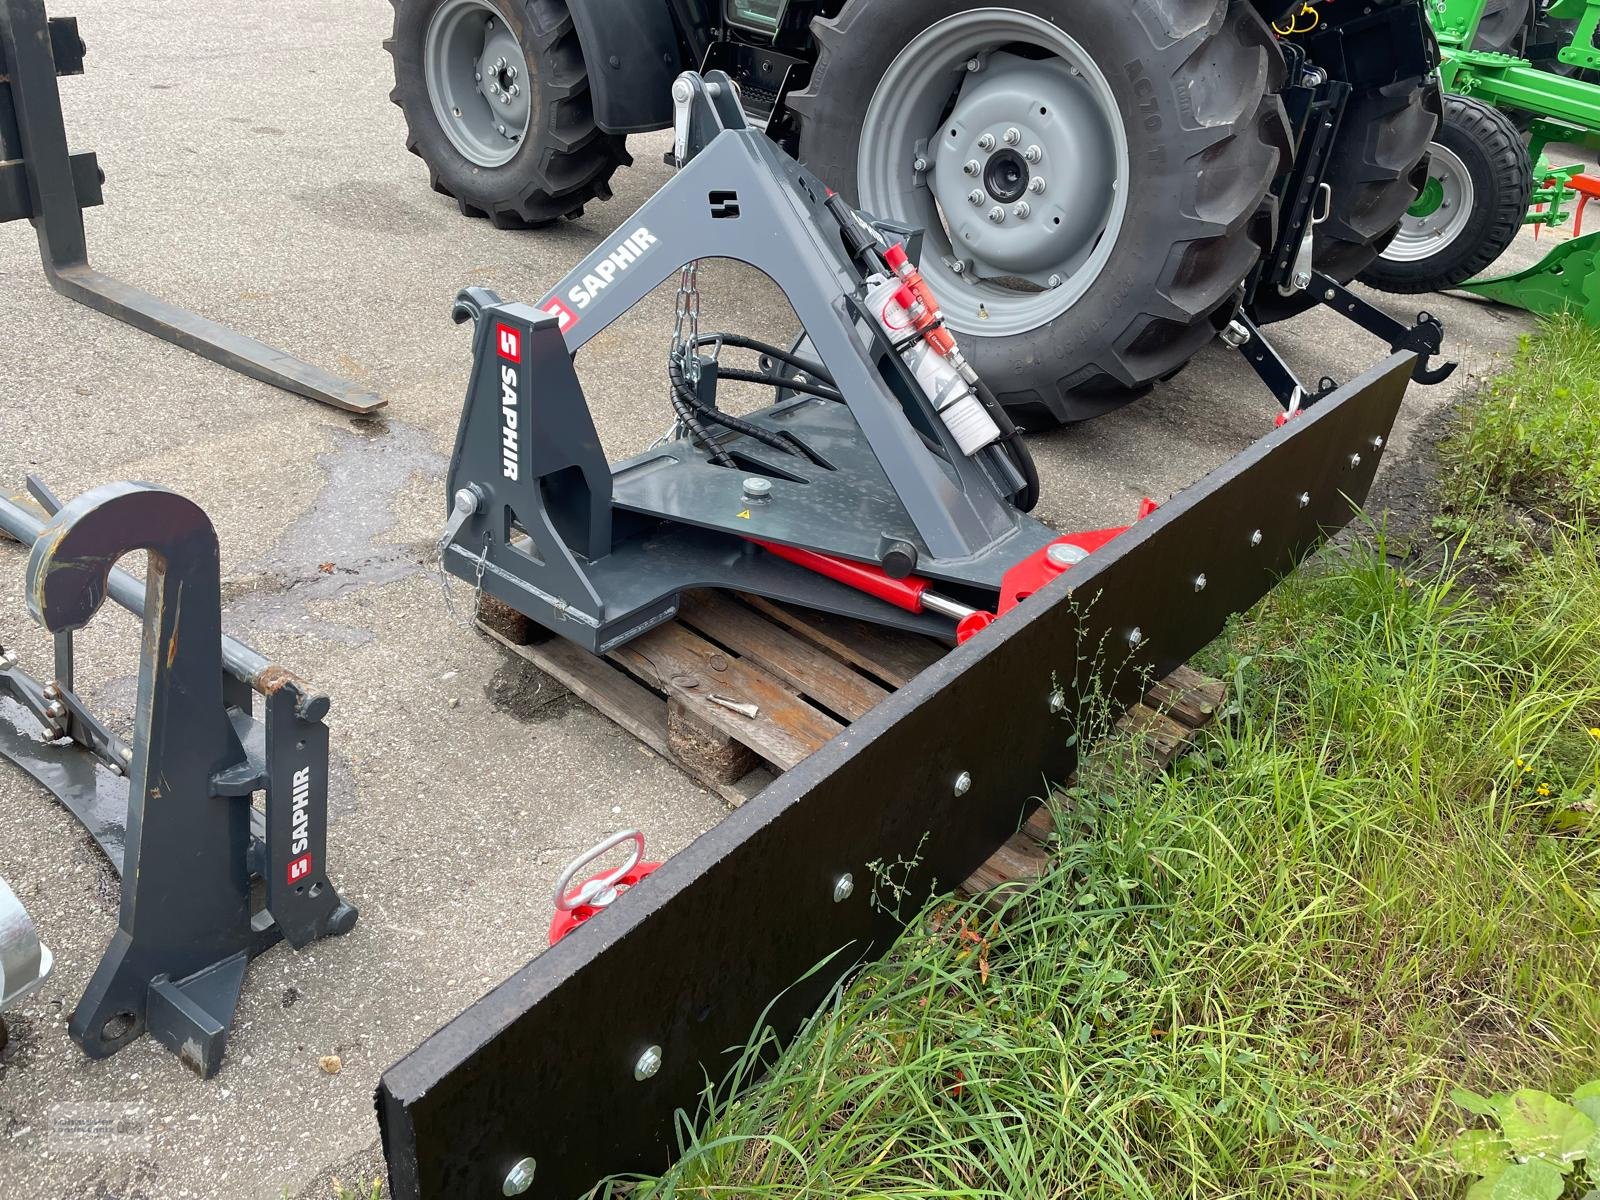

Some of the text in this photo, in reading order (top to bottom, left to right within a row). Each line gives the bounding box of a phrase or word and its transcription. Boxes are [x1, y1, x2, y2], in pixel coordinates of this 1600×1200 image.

[568, 226, 657, 310] SAPHIR
[501, 364, 519, 482] SAPHIR
[291, 766, 310, 855] SAPHIR
